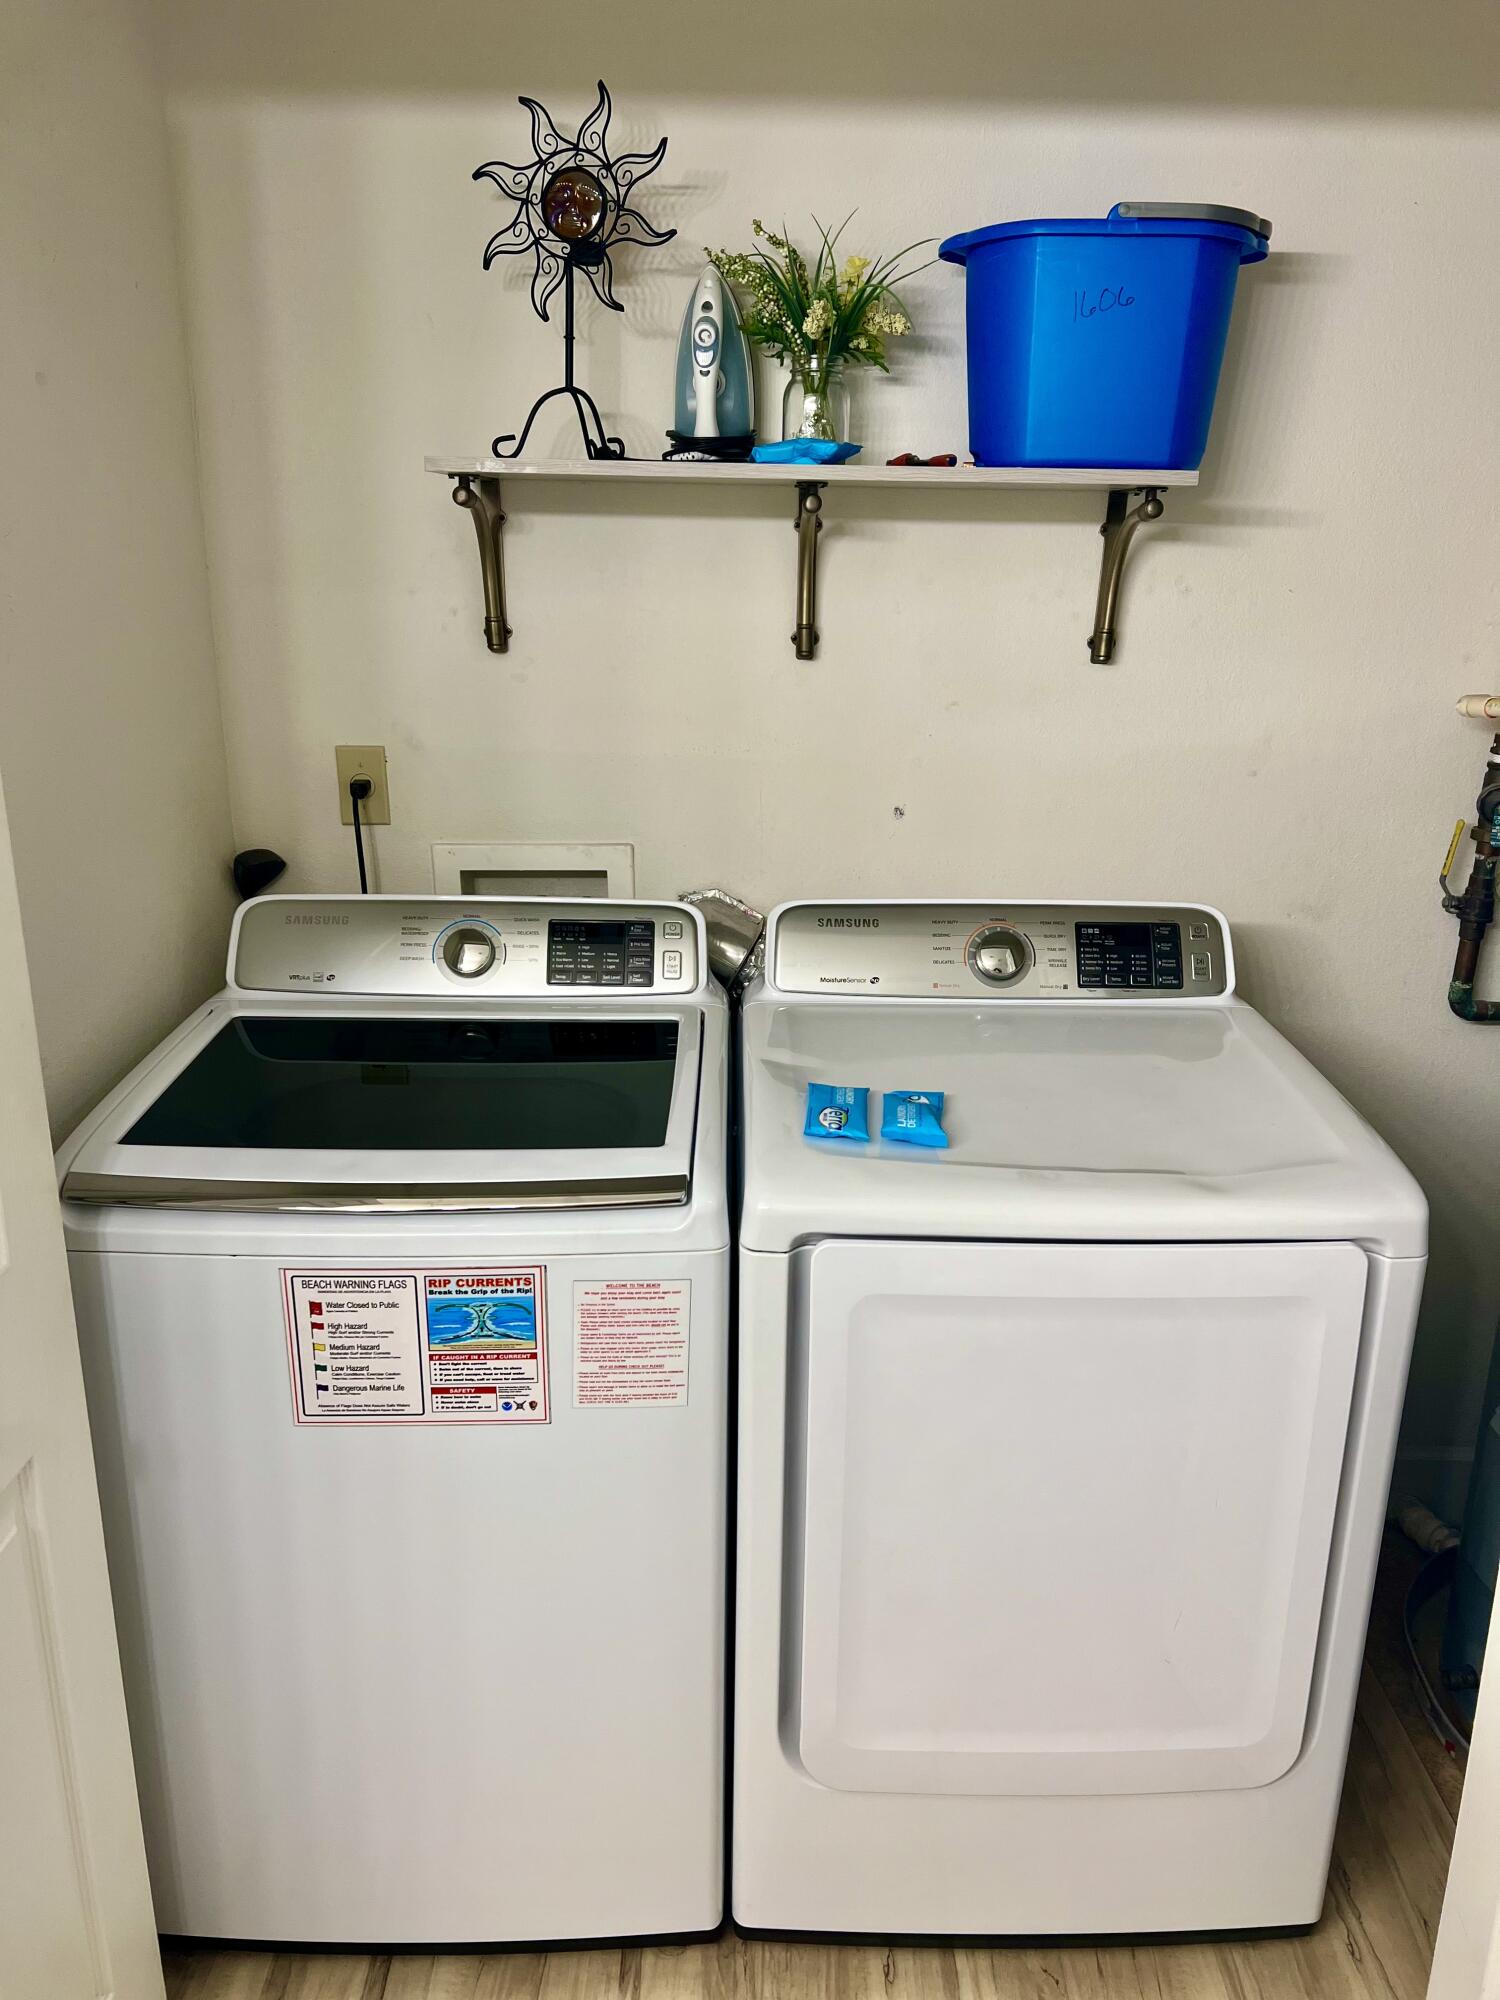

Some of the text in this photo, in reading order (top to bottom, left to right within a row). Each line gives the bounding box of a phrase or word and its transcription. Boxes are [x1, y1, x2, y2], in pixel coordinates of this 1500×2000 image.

[1073, 286, 1136, 323] 1606
[285, 915, 350, 925] SAMSUNG
[817, 918, 880, 928] SAMSUNG
[301, 1280, 407, 1289] BEACH WARNING FLAGS
[428, 1277, 532, 1288] RIP CURRENTS
[328, 1323, 342, 1331] High
